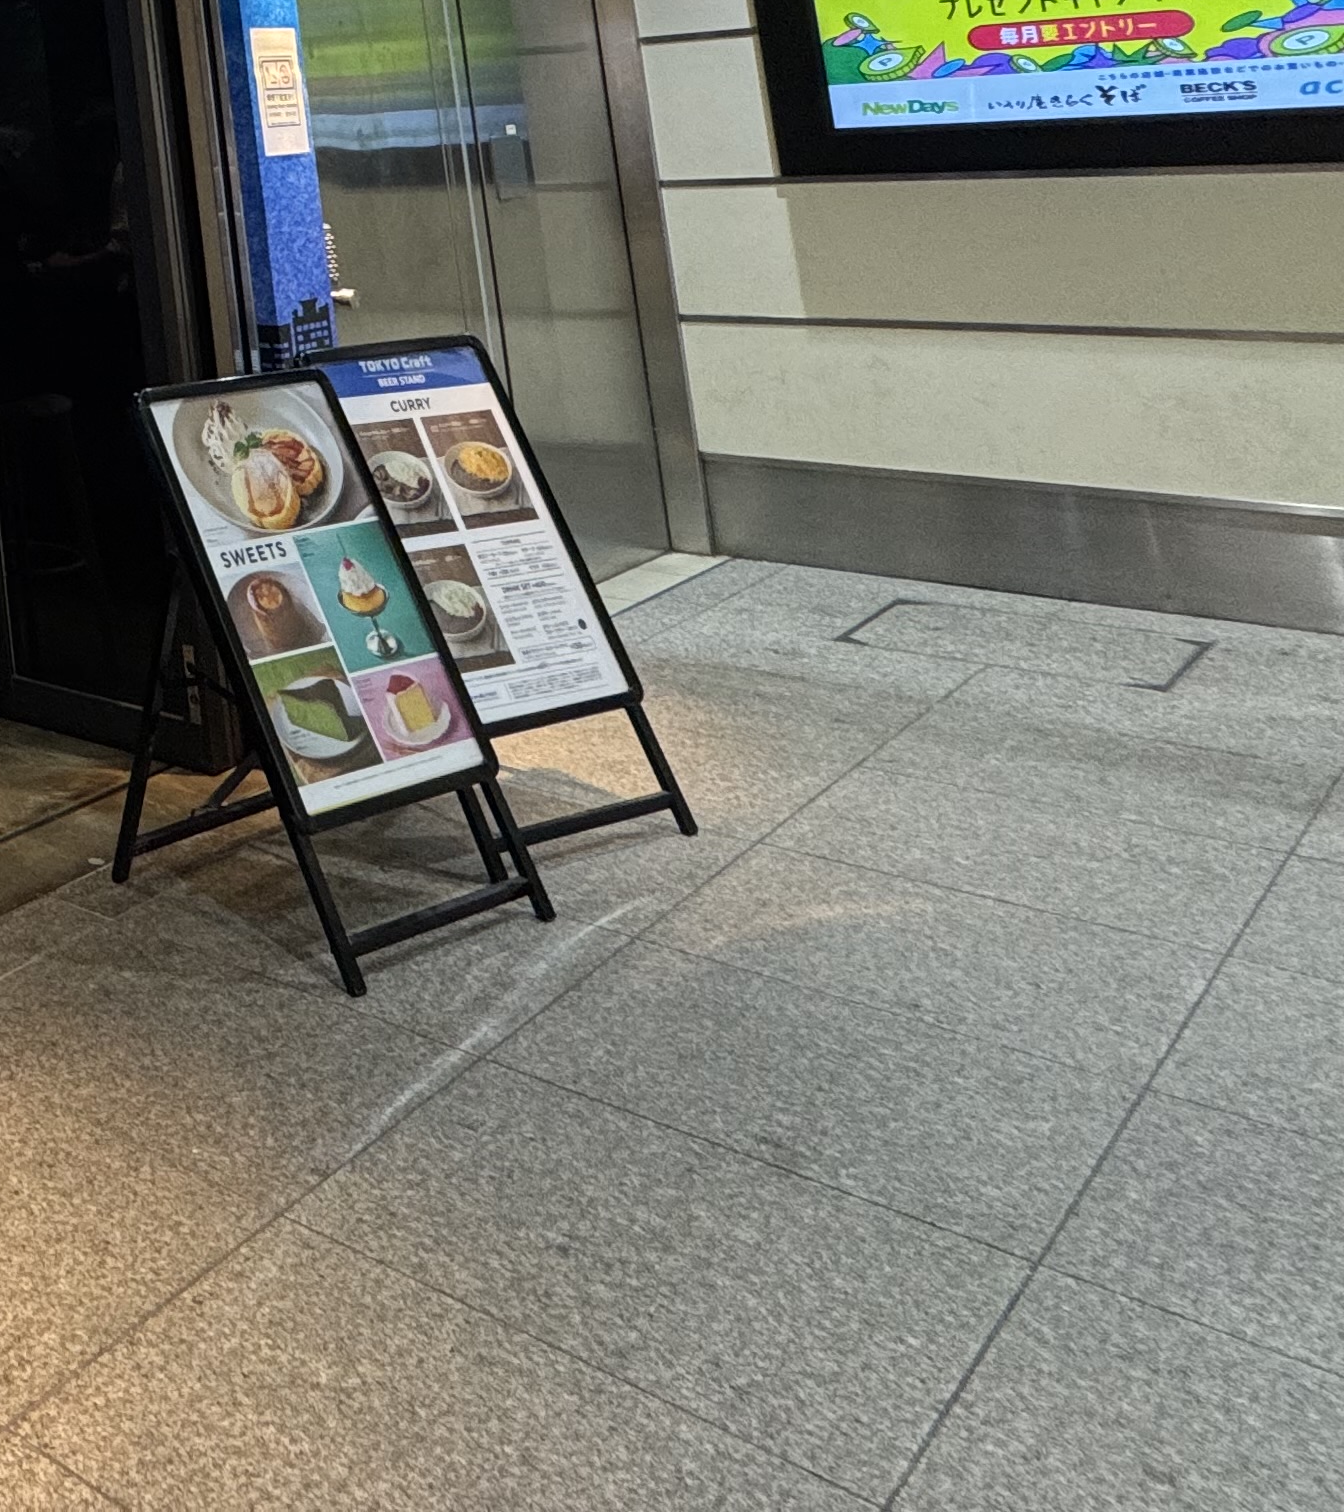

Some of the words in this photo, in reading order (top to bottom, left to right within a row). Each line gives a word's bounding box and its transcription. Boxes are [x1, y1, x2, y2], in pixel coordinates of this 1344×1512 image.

[1000, 18, 1157, 45] 毎月要エントリー
[862, 99, 959, 116] NewDays
[358, 357, 400, 373] TOKYO
[377, 375, 399, 388] BEER
[400, 374, 426, 386] STAND
[390, 397, 431, 412] CURRY
[220, 541, 287, 568] SWEETS
